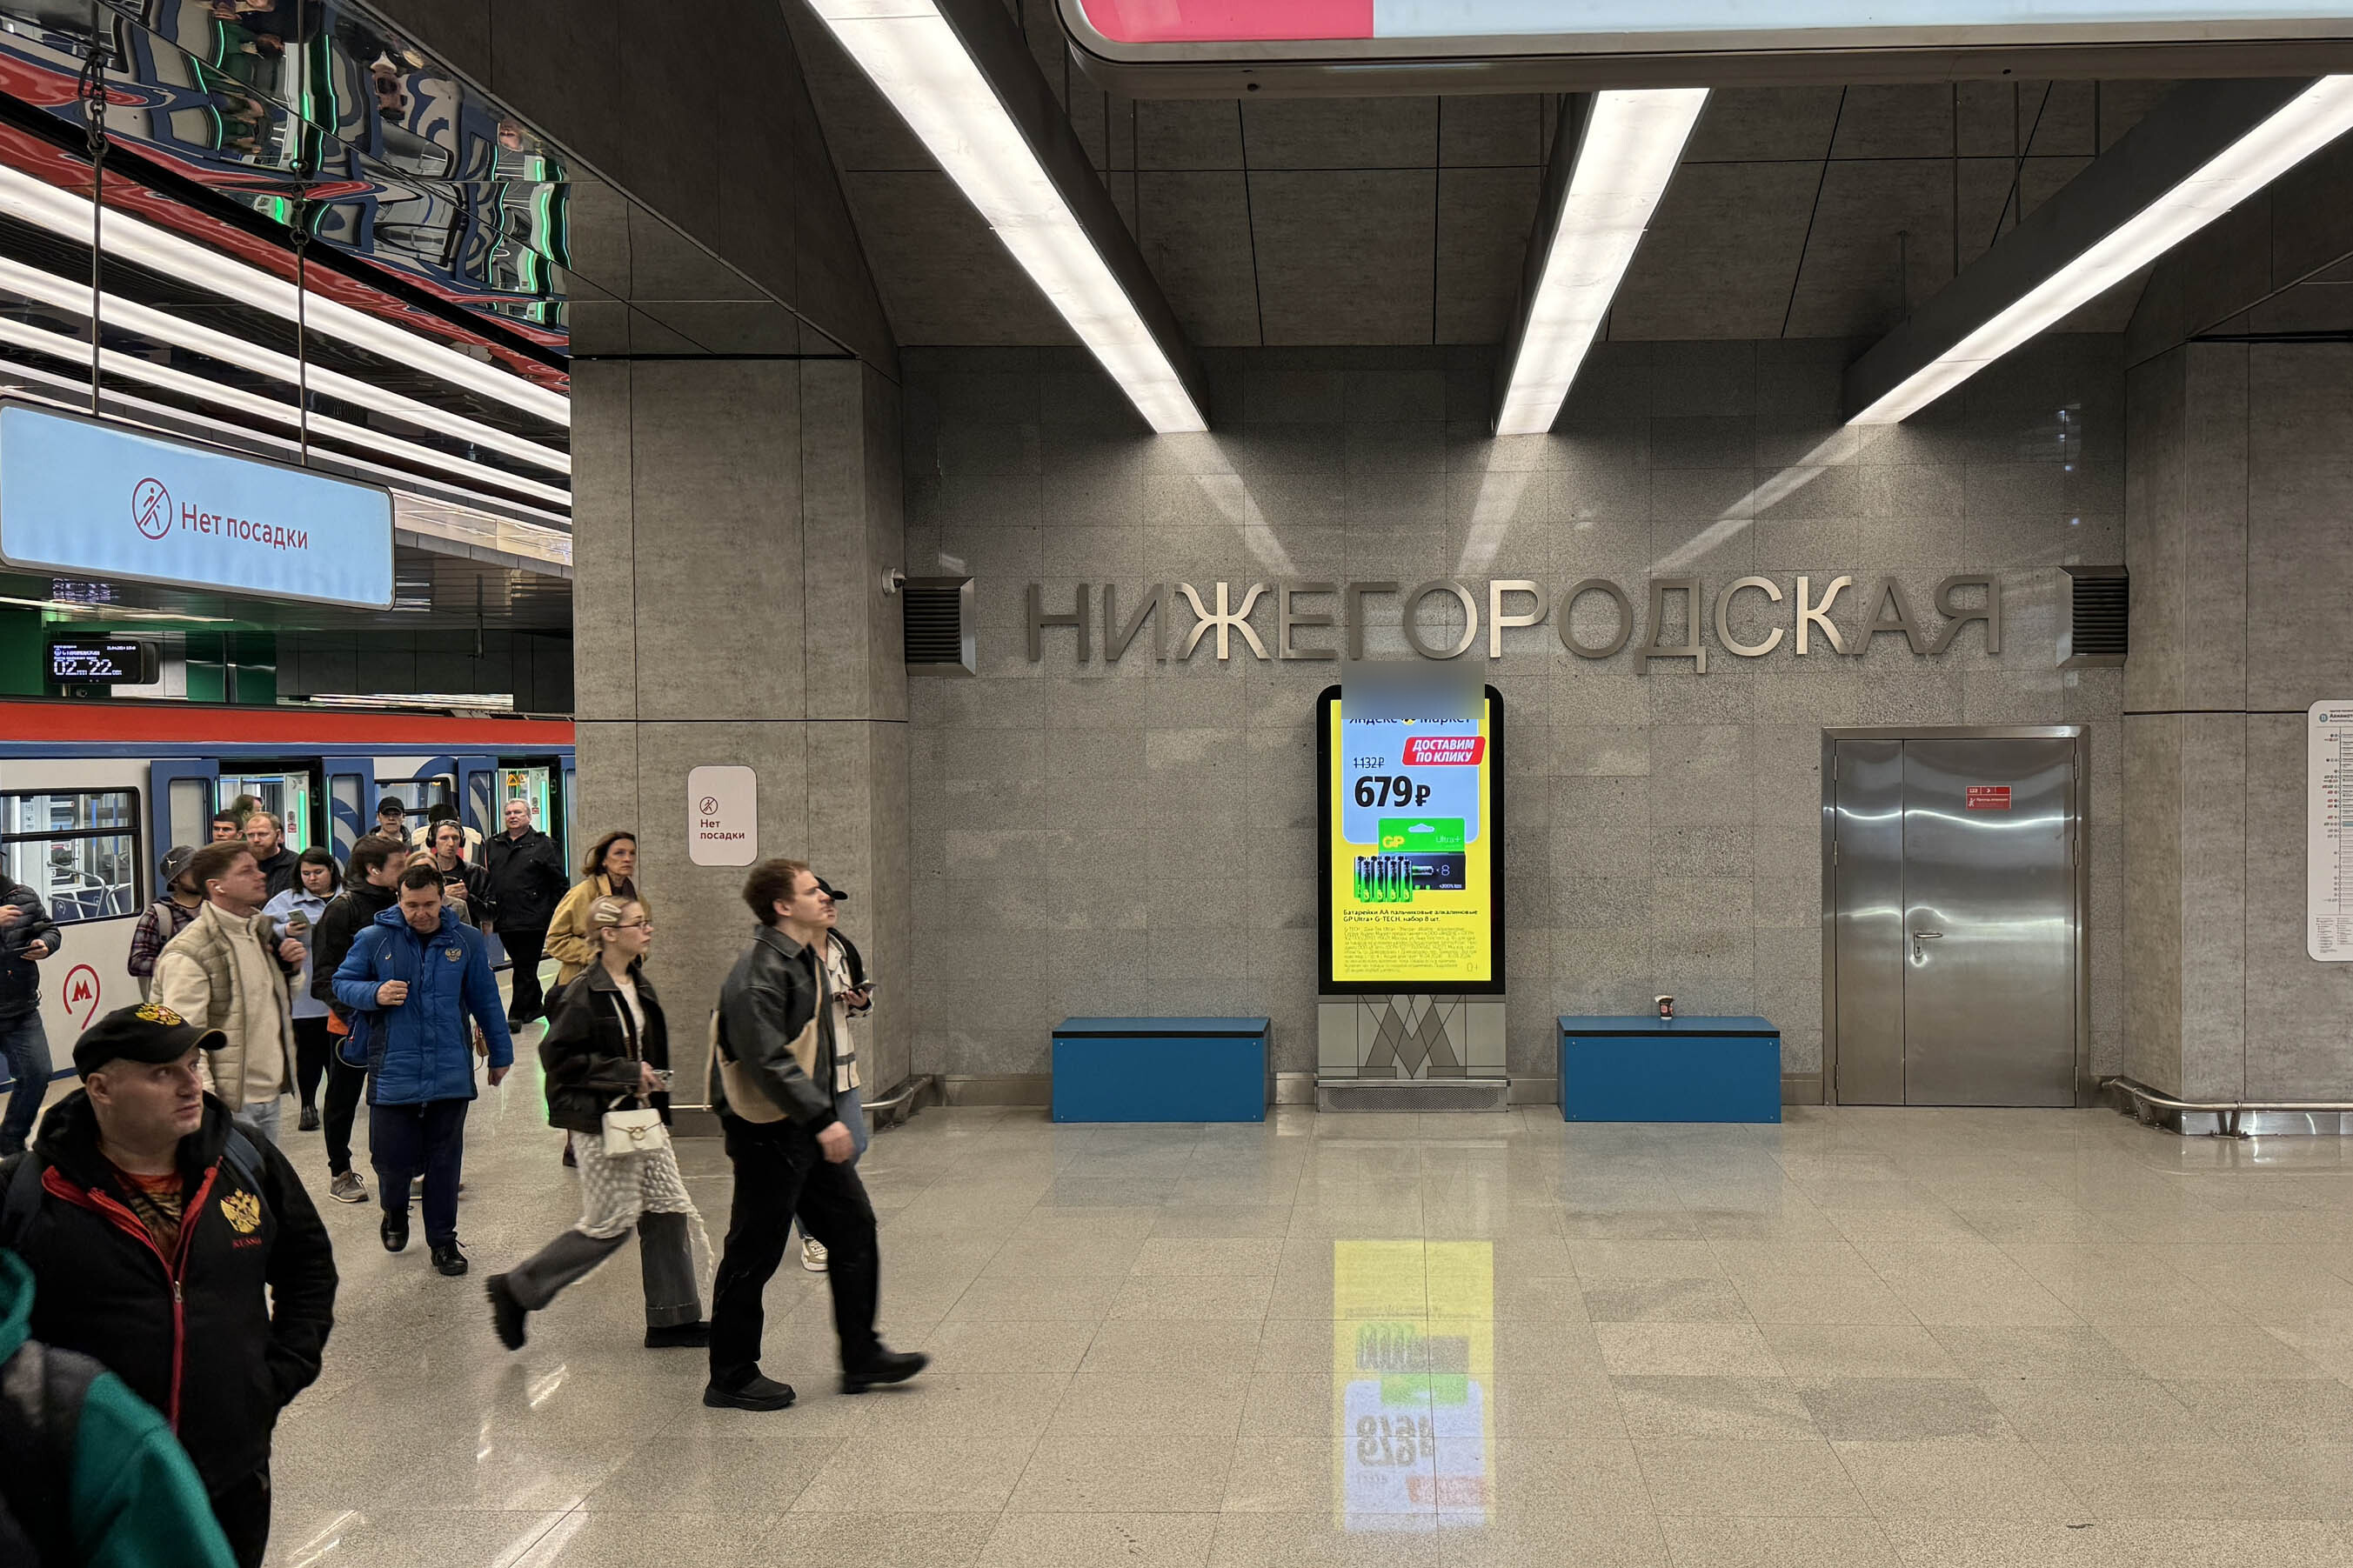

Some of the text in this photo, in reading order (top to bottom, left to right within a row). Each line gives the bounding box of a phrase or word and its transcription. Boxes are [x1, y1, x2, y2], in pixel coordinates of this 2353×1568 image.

[181, 502, 308, 550] Нет посадки
[1027, 574, 2000, 674] НИЖЕГОРОДСКАЯ
[53, 659, 77, 676] 02
[89, 659, 112, 676] 22
[1413, 739, 1475, 752] ДОСТАВИМ
[1415, 751, 1474, 763] ПО КЛИКУ
[699, 818, 721, 829] Нет
[699, 831, 745, 841] посадки
[1381, 836, 1405, 848] GP
